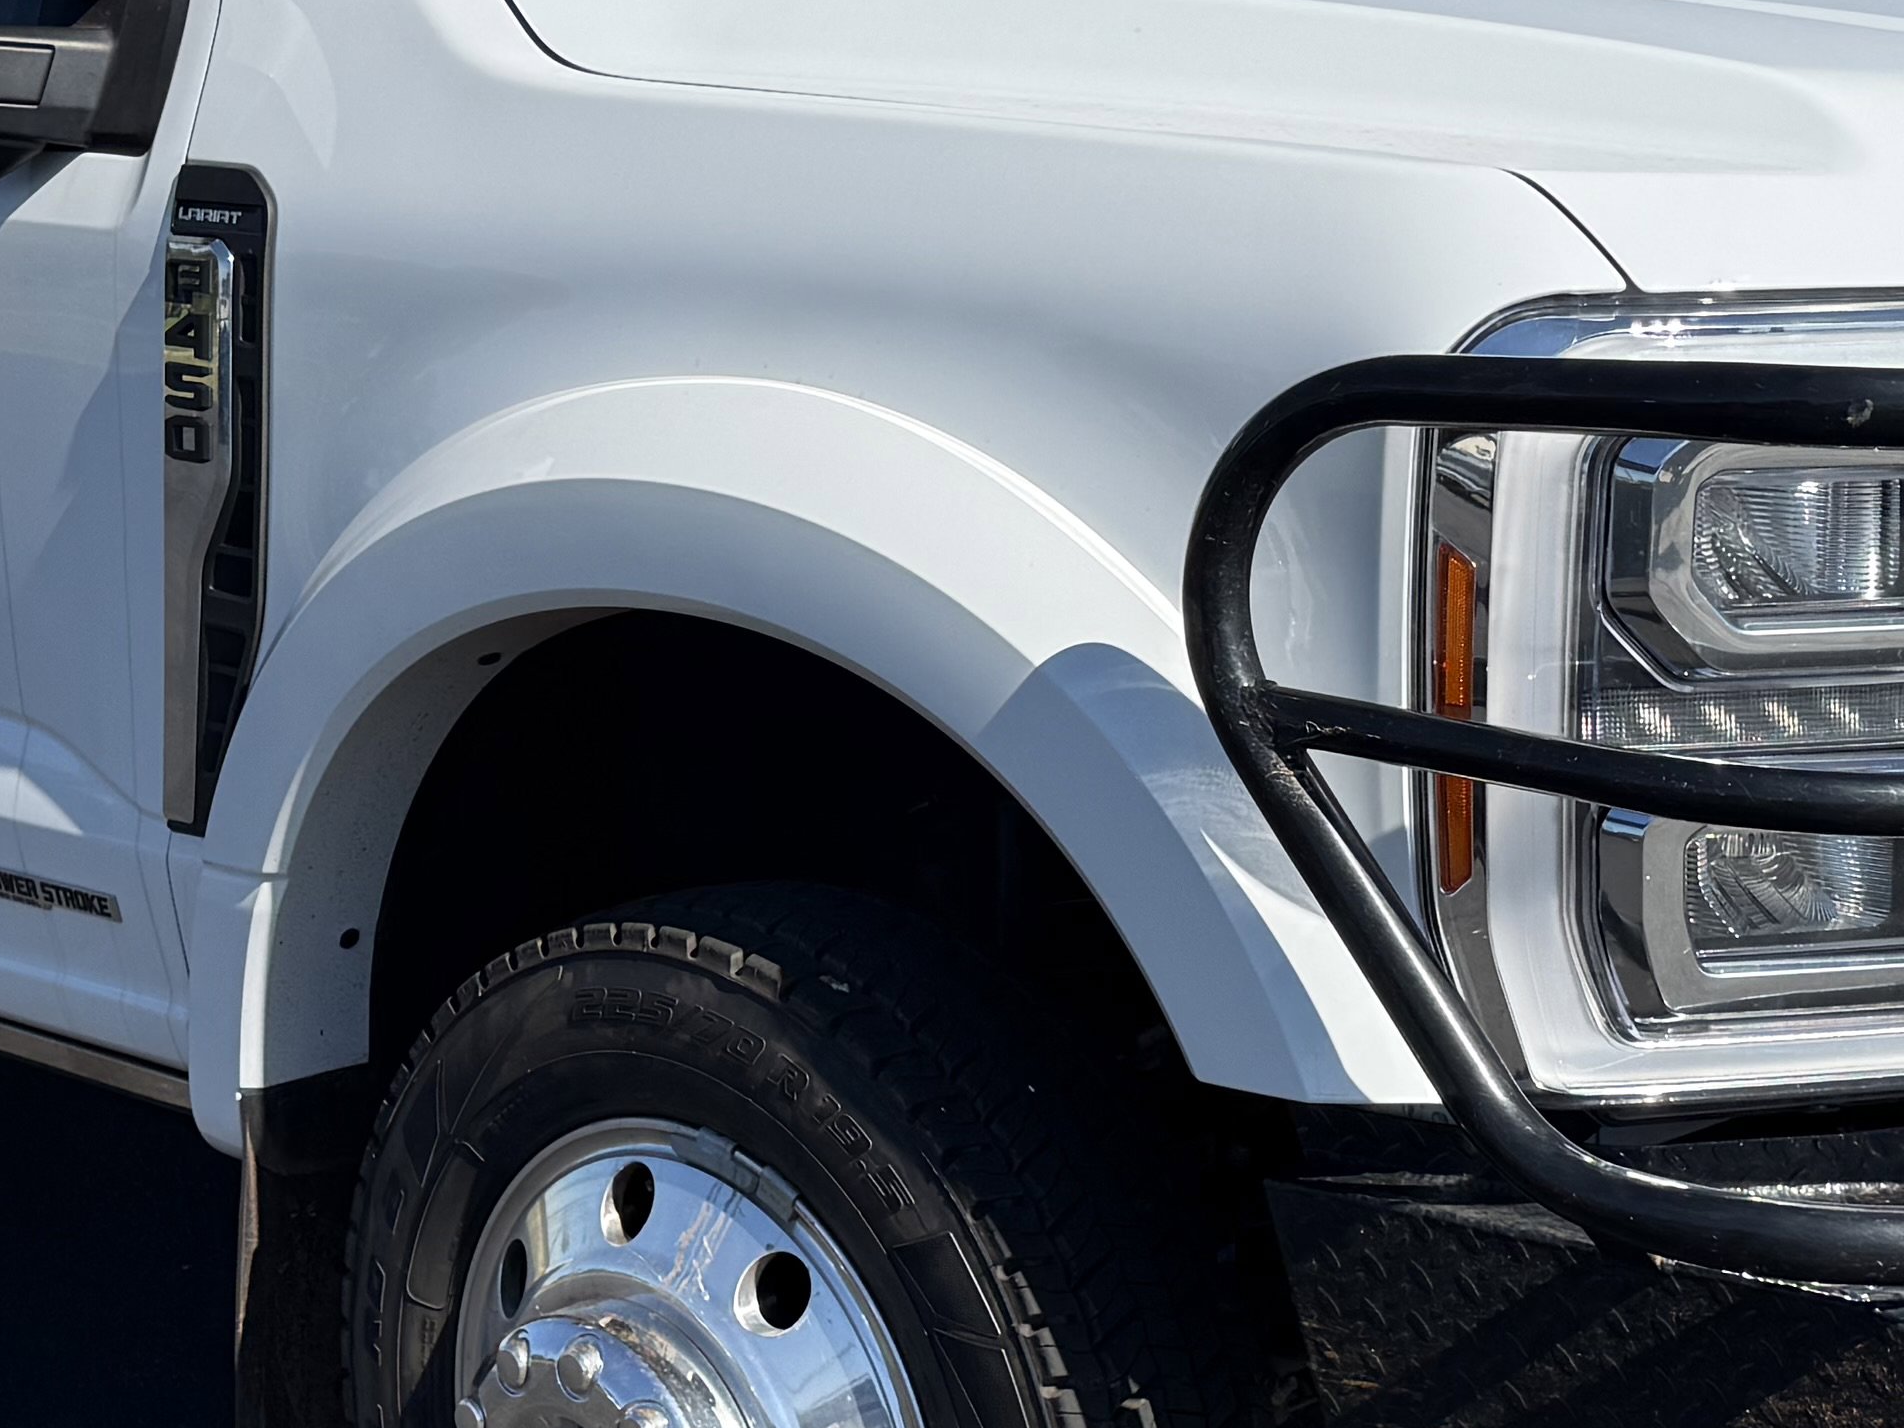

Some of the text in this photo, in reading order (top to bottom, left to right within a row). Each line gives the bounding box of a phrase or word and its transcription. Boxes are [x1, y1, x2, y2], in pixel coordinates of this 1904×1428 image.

[178, 206, 242, 225] LARIAT
[40, 880, 112, 918] STROKE
[571, 986, 766, 1067] 225/70
